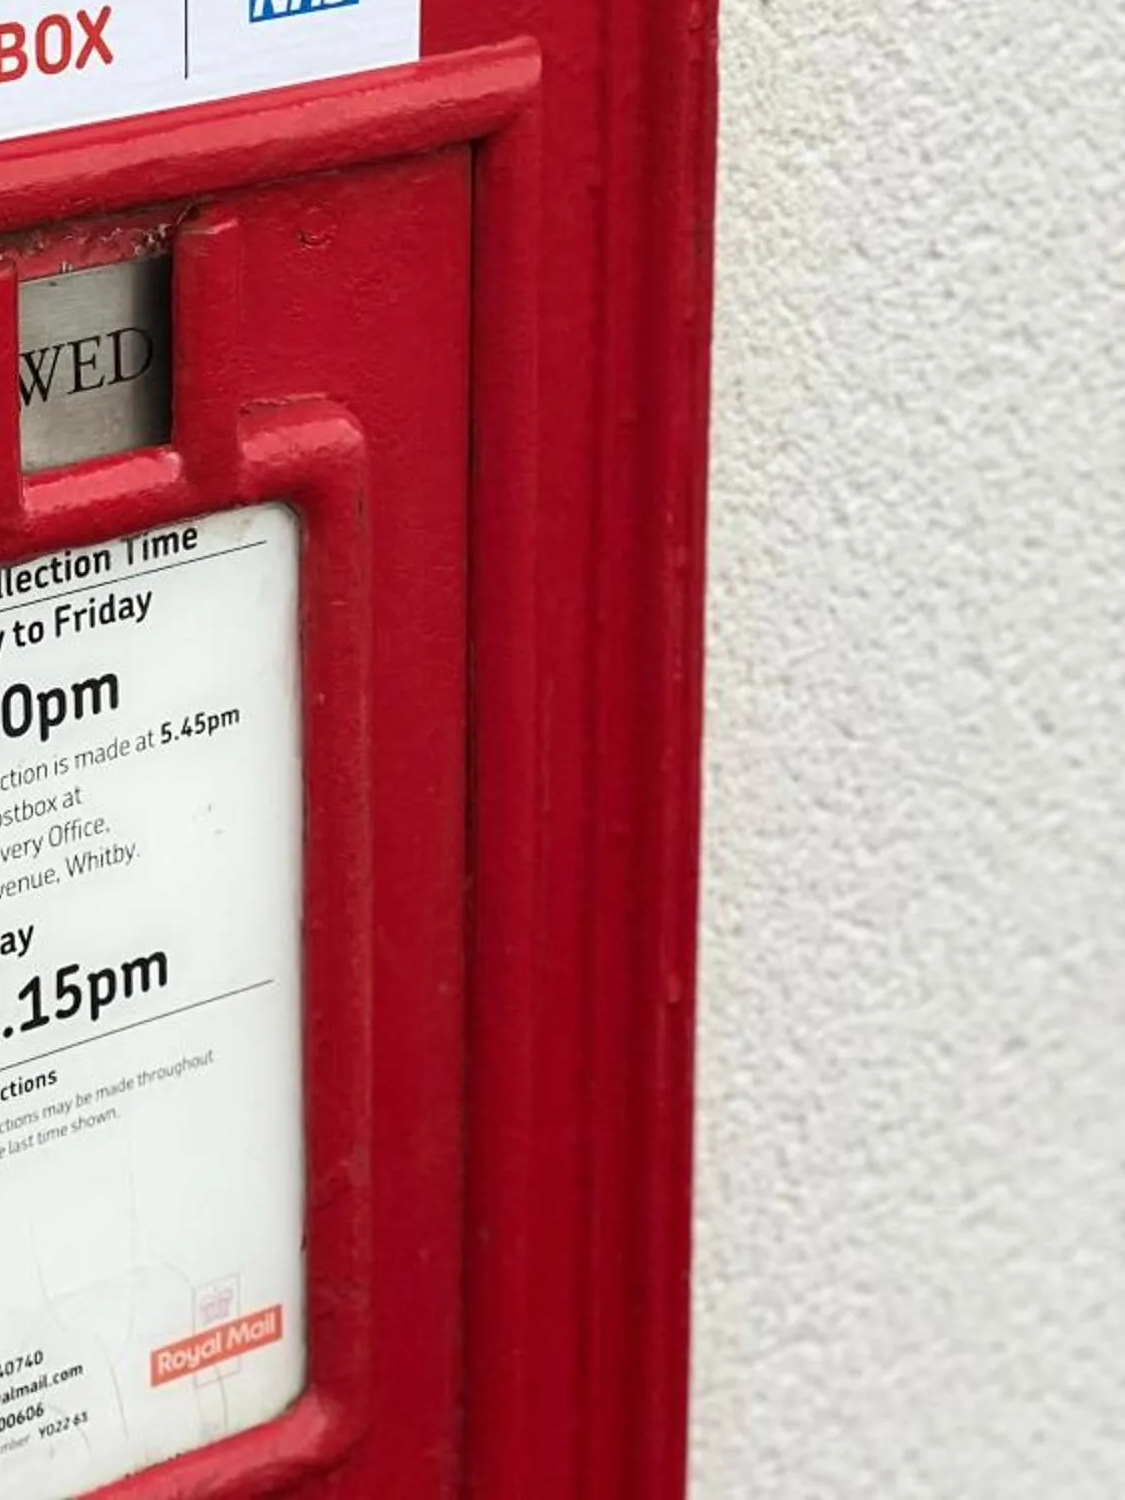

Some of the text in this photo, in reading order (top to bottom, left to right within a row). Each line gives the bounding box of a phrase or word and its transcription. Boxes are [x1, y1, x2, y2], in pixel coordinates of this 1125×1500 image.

[19, 326, 154, 408] WED
[121, 526, 198, 565] Time
[13, 617, 45, 647] to
[54, 591, 153, 637] Friday
[54, 753, 69, 775] is
[75, 738, 130, 770] made
[135, 729, 155, 752] at
[160, 708, 241, 745] 5.45pm
[62, 785, 82, 809] at
[42, 1099, 73, 1119] may
[75, 1092, 92, 1108] be
[96, 1078, 135, 1101] made
[137, 1049, 214, 1088] throughout
[8, 1134, 34, 1155] last
[37, 1123, 68, 1145] time
[158, 1311, 275, 1375] Royal Mail
